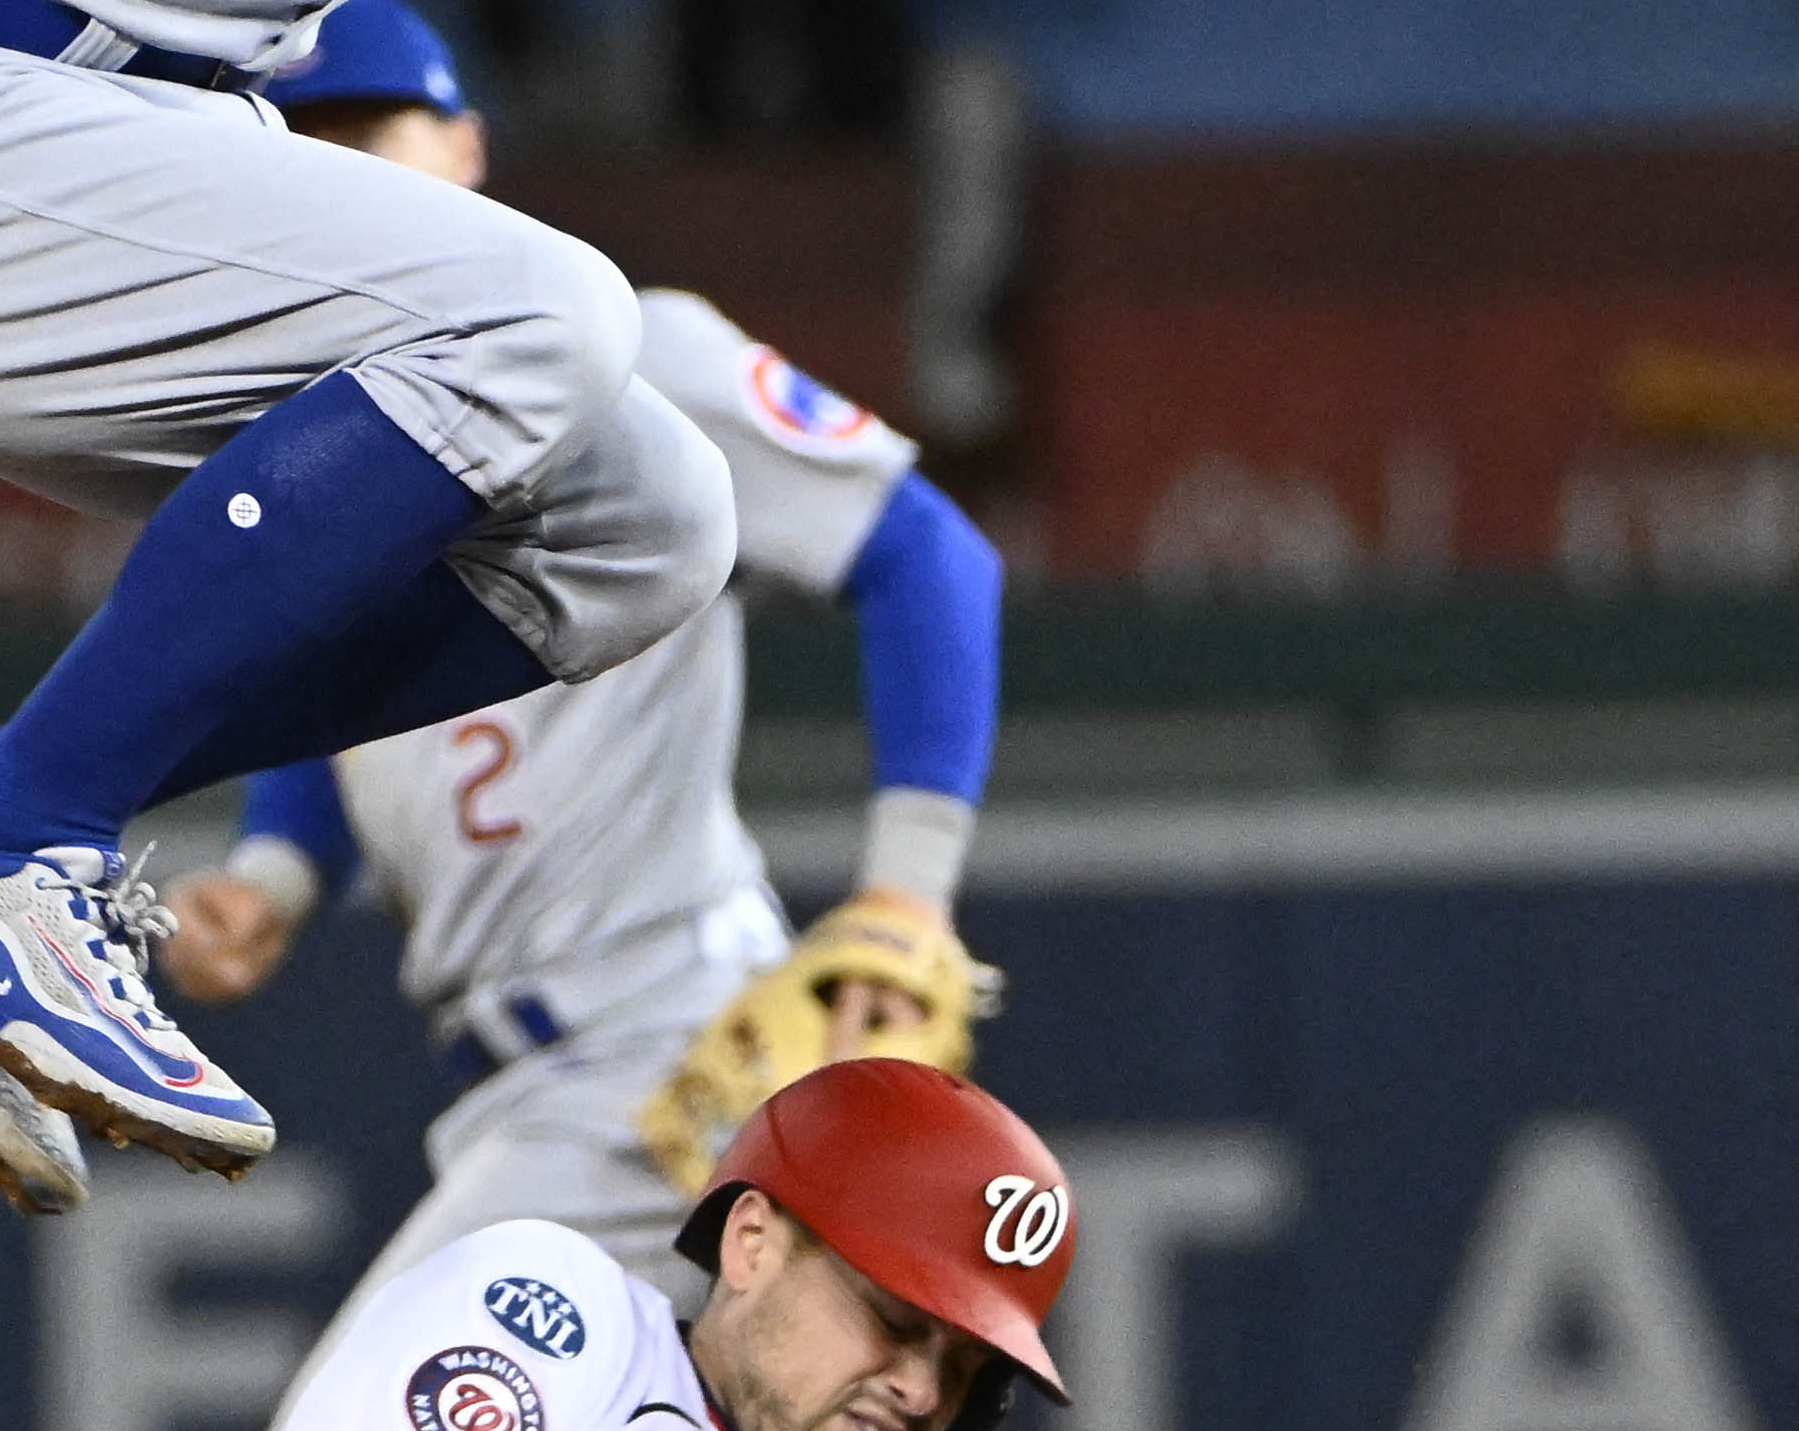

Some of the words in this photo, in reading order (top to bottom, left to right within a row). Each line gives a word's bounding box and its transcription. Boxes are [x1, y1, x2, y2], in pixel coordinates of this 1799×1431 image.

[451, 719, 524, 847] 2
[984, 1174, 1069, 1267] W
[488, 1280, 579, 1359] TNL
